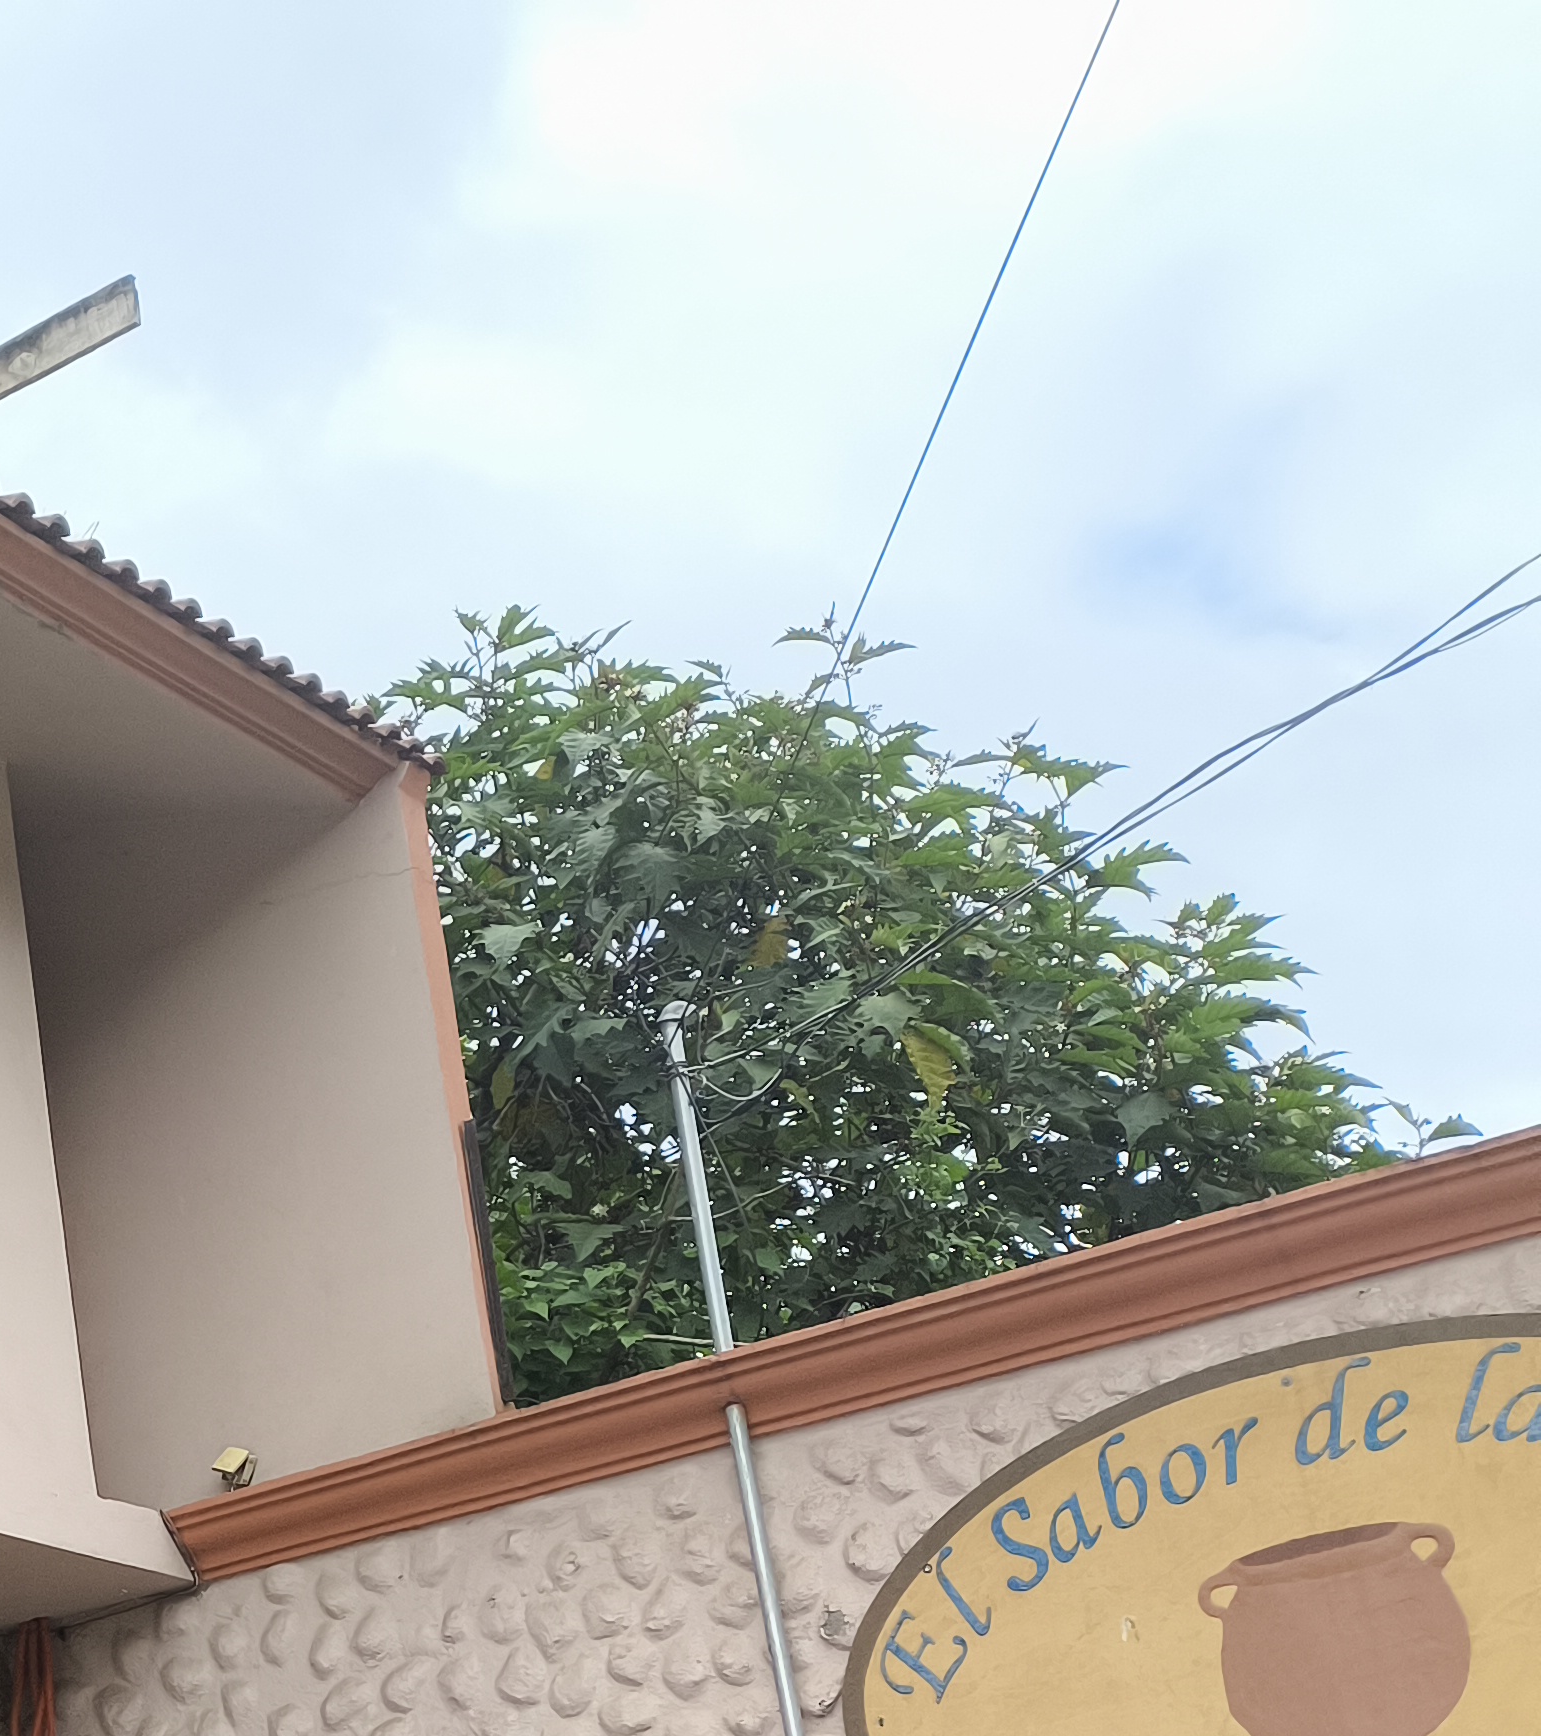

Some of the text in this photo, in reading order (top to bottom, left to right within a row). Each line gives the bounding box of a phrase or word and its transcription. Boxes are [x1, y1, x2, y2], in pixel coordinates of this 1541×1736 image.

[879, 1341, 1541, 1705] El Sabor de la
